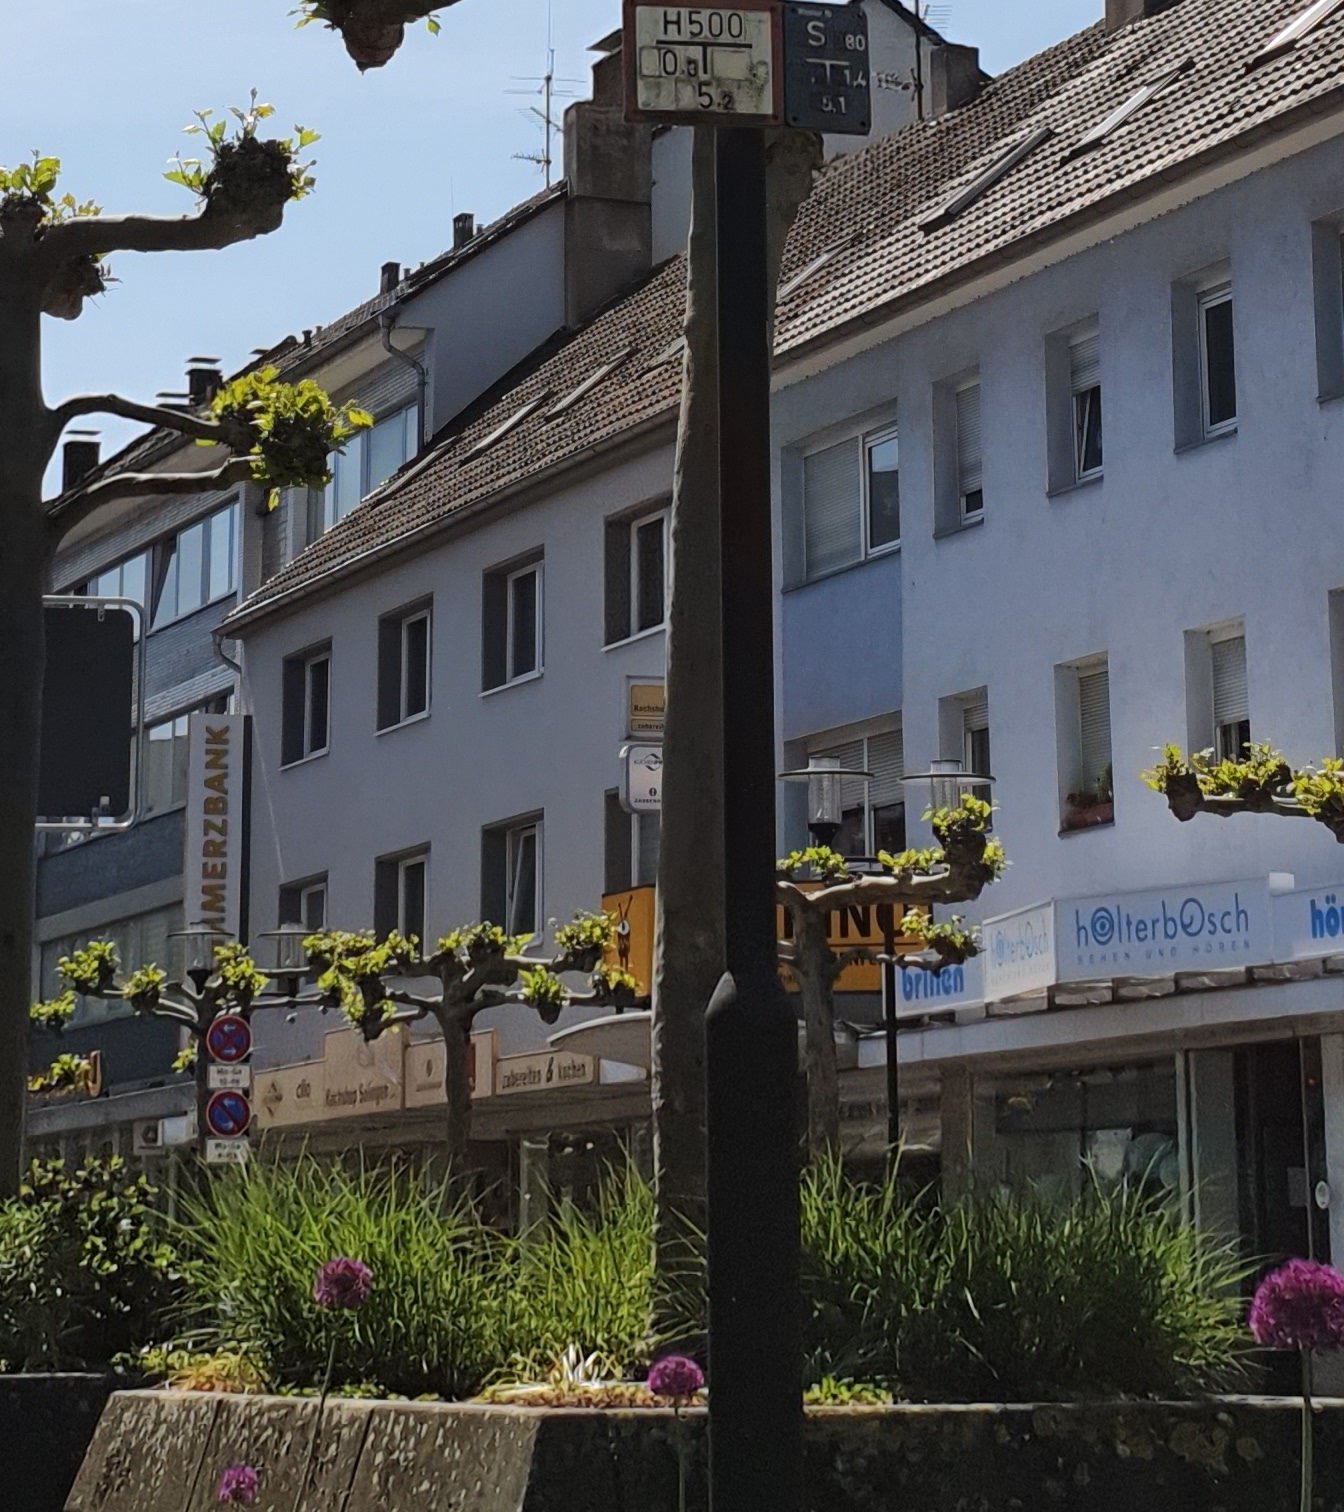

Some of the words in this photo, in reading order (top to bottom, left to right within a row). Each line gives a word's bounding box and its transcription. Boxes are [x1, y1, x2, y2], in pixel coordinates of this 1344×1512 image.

[663, 10, 743, 38] H500
[807, 21, 825, 46] S
[1075, 894, 1250, 943] holterbosch
[1145, 946, 1178, 960] UND
